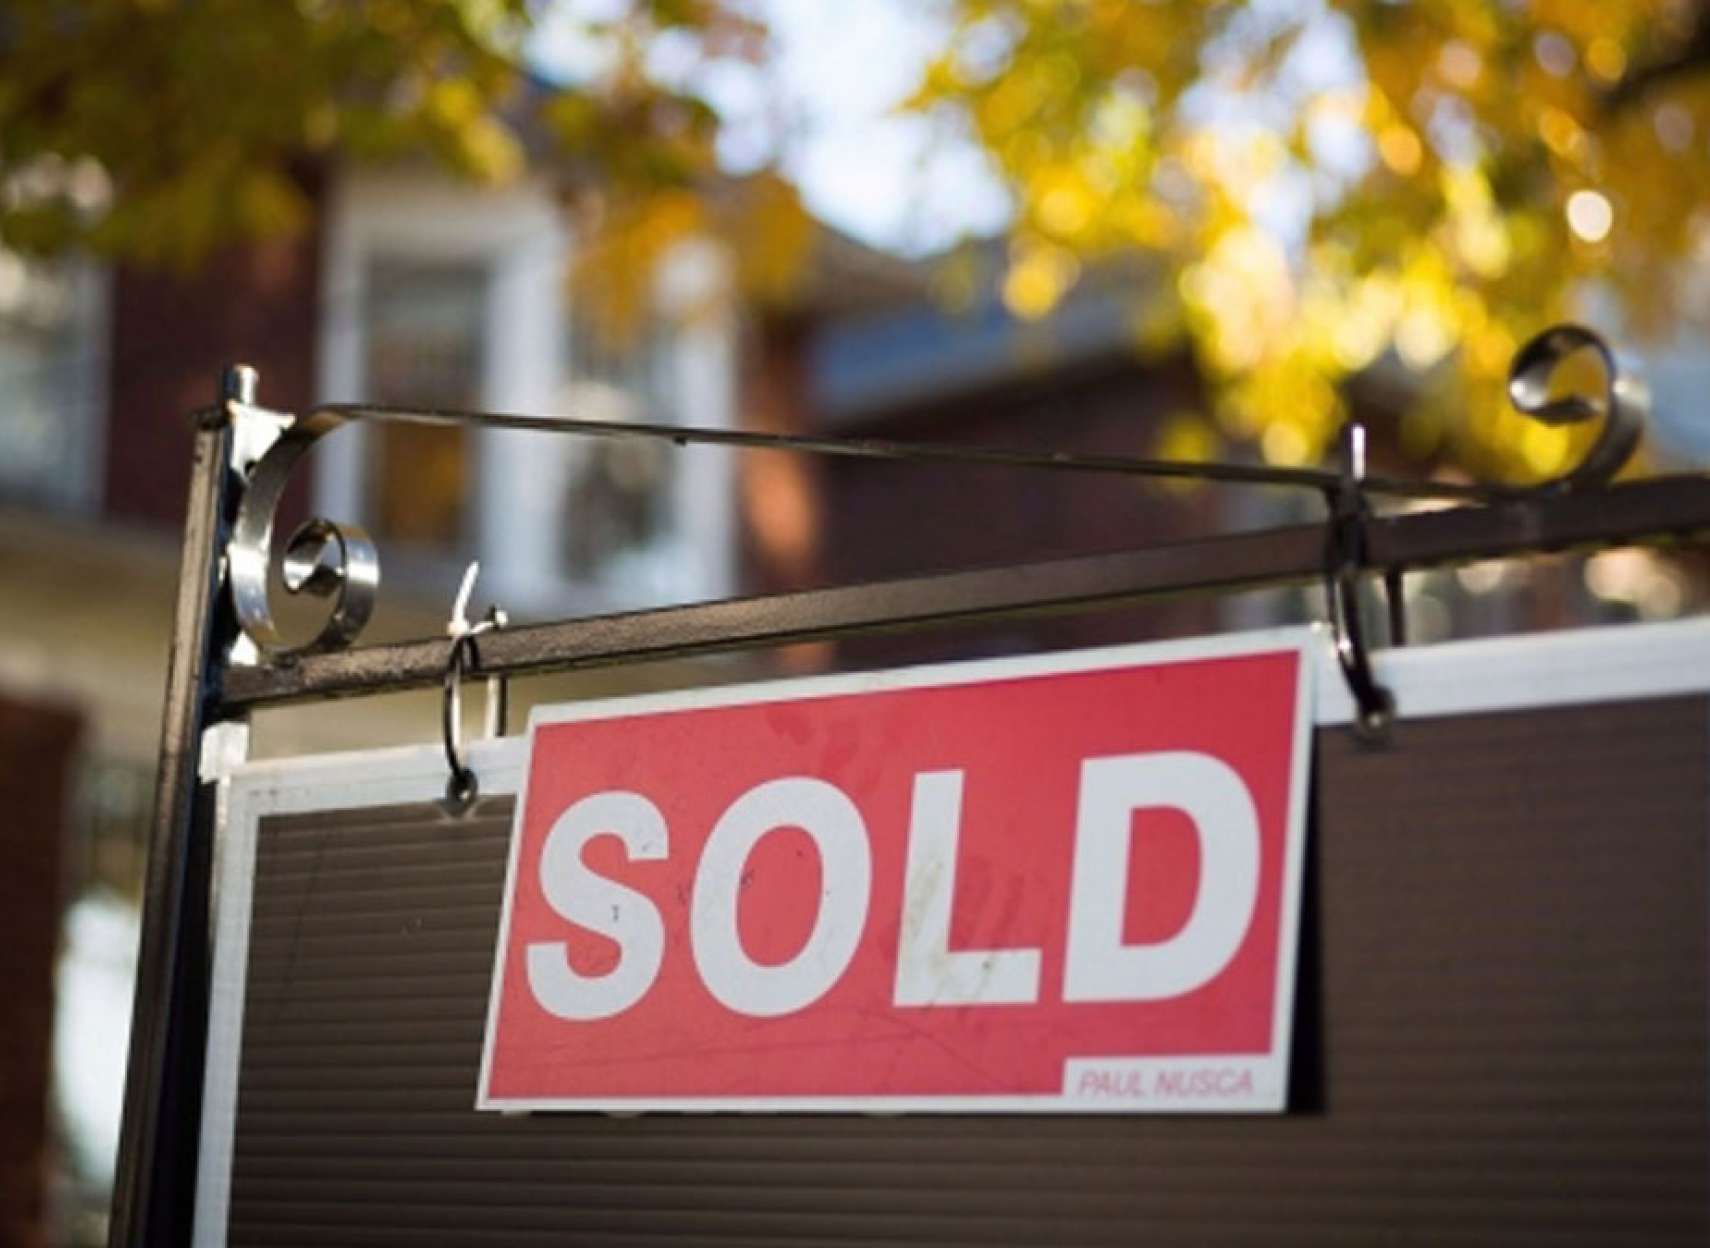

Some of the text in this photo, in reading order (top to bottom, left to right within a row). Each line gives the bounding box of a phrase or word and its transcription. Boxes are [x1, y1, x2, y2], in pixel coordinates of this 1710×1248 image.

[525, 751, 1260, 1020] SOLD
[1077, 1068, 1254, 1097] PAUL NUSCA
